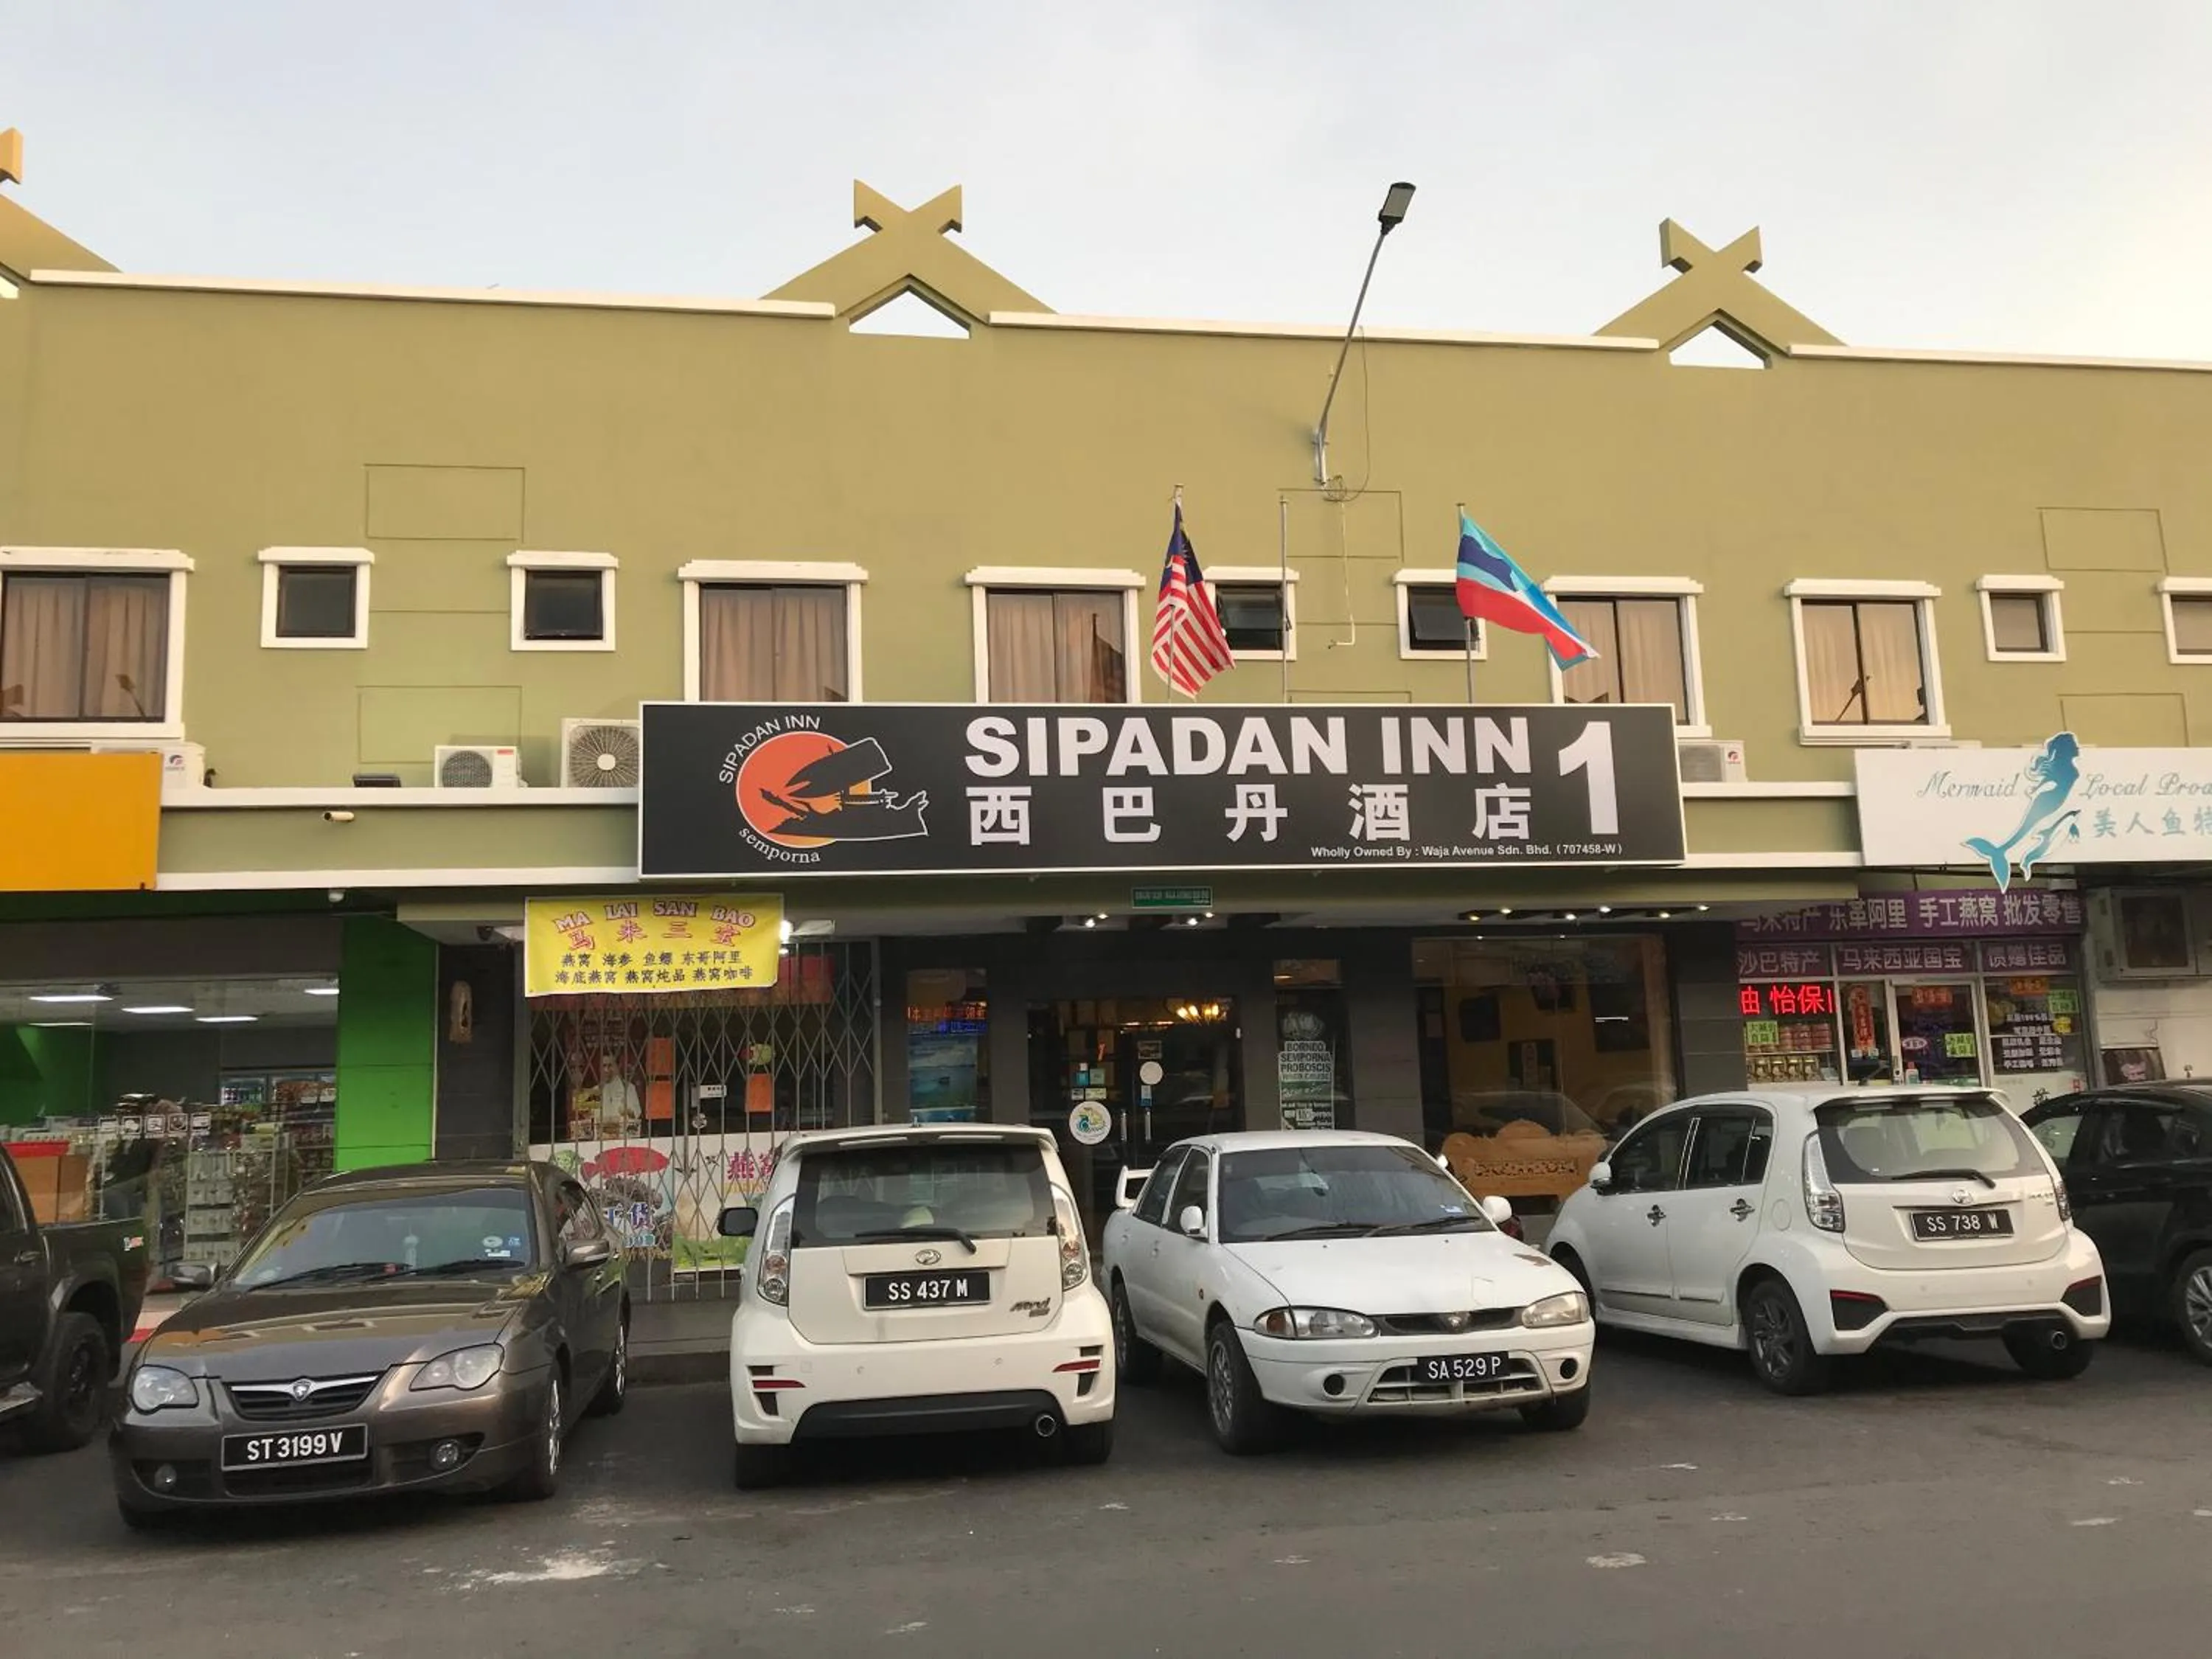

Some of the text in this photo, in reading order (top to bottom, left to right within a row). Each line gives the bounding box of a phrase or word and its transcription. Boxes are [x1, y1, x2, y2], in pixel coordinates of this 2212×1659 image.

[719, 714, 821, 784] SIPADAN INN
[965, 717, 1619, 835] SIPADAN INN 1
[1917, 771, 2021, 799] Mermaid
[2079, 773, 2149, 799] Local
[965, 783, 1531, 846] 西巴丹酒店
[739, 827, 821, 863] semporna
[1311, 846, 1350, 859] Wholly
[1353, 846, 1394, 858] Owned
[1397, 846, 1412, 858] By
[1422, 845, 1450, 858] Waja
[1452, 845, 1495, 856] Avenue
[1497, 844, 1524, 855] Sdn.
[1526, 844, 1552, 855] Bhd.
[553, 900, 756, 933] MA LAI SAN BAO
[1919, 895, 1999, 928] 手工燕窝
[2003, 894, 2082, 927] 批发零售
[1737, 950, 1821, 974] 沙巴特产
[1841, 945, 1964, 972] 马来西亚国宝
[1770, 984, 1833, 1015] 怡保
[1927, 1216, 1947, 1232] SS
[1951, 1214, 1981, 1231] 738
[888, 1279, 968, 1300] SS 437 M
[1427, 1357, 1501, 1380] SA 529 P
[247, 1432, 343, 1460] ST 3199 V
